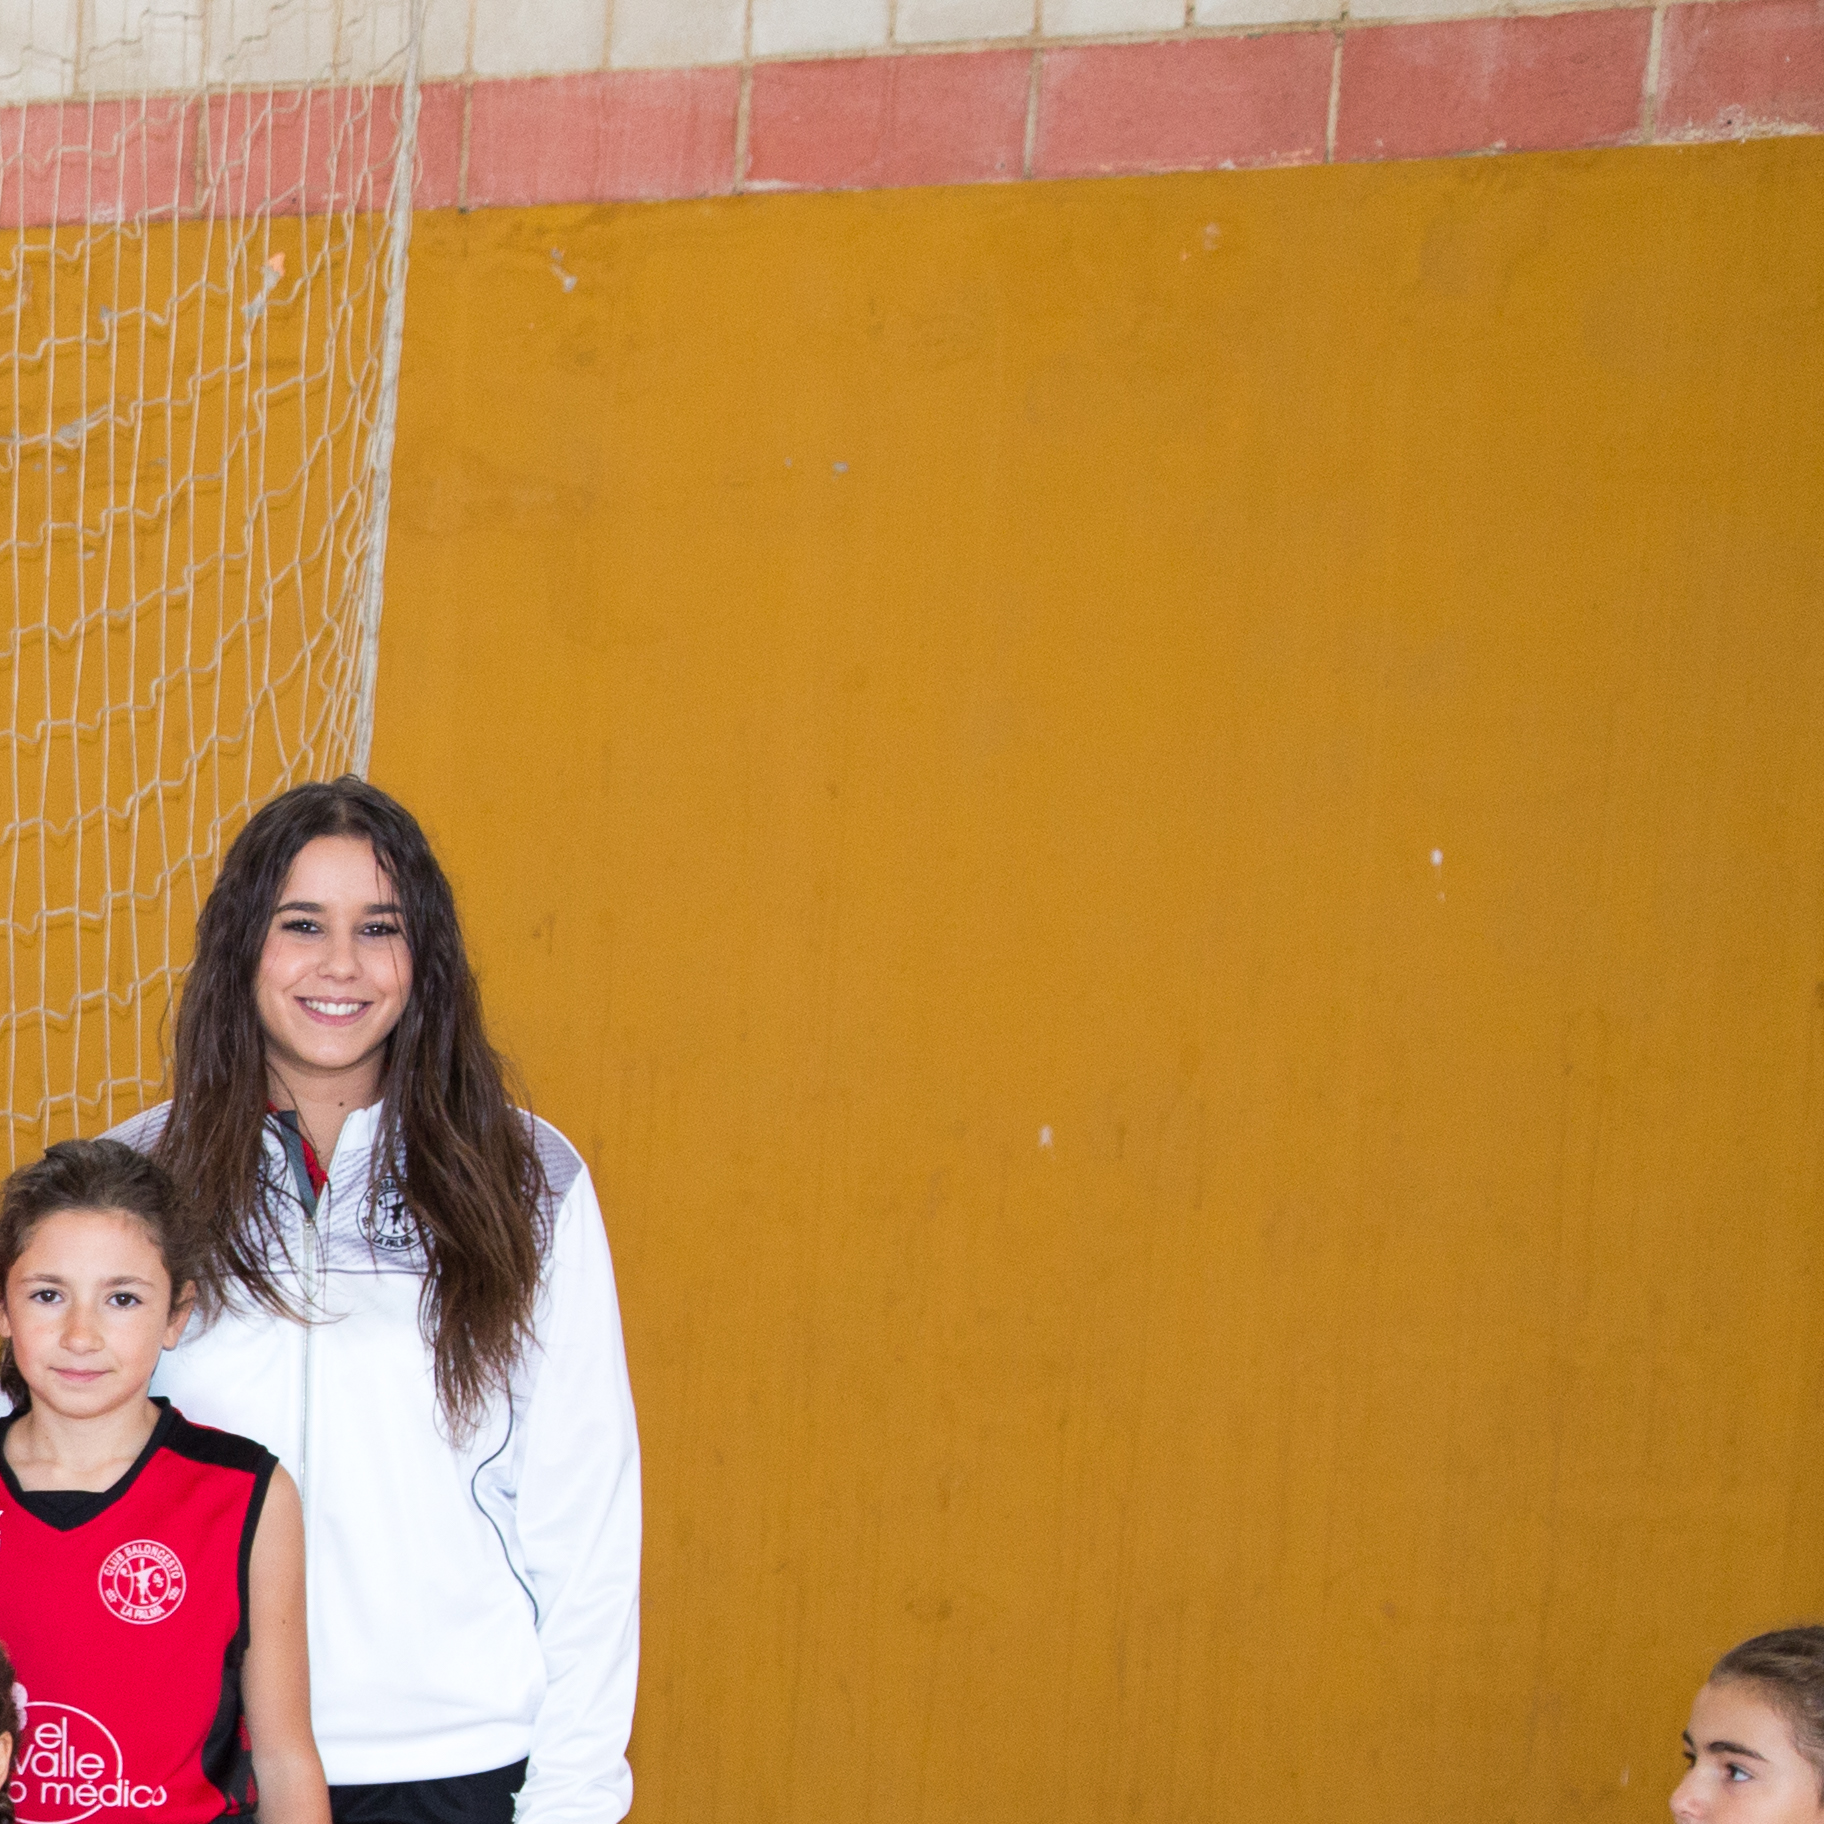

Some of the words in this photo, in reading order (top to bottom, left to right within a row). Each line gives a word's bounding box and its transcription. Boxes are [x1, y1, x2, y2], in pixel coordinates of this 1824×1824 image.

[103, 1552, 125, 1577] CLUB
[124, 1544, 182, 1579] BALONCESTO
[120, 1604, 133, 1617] LA
[133, 1604, 166, 1619] PALMA
